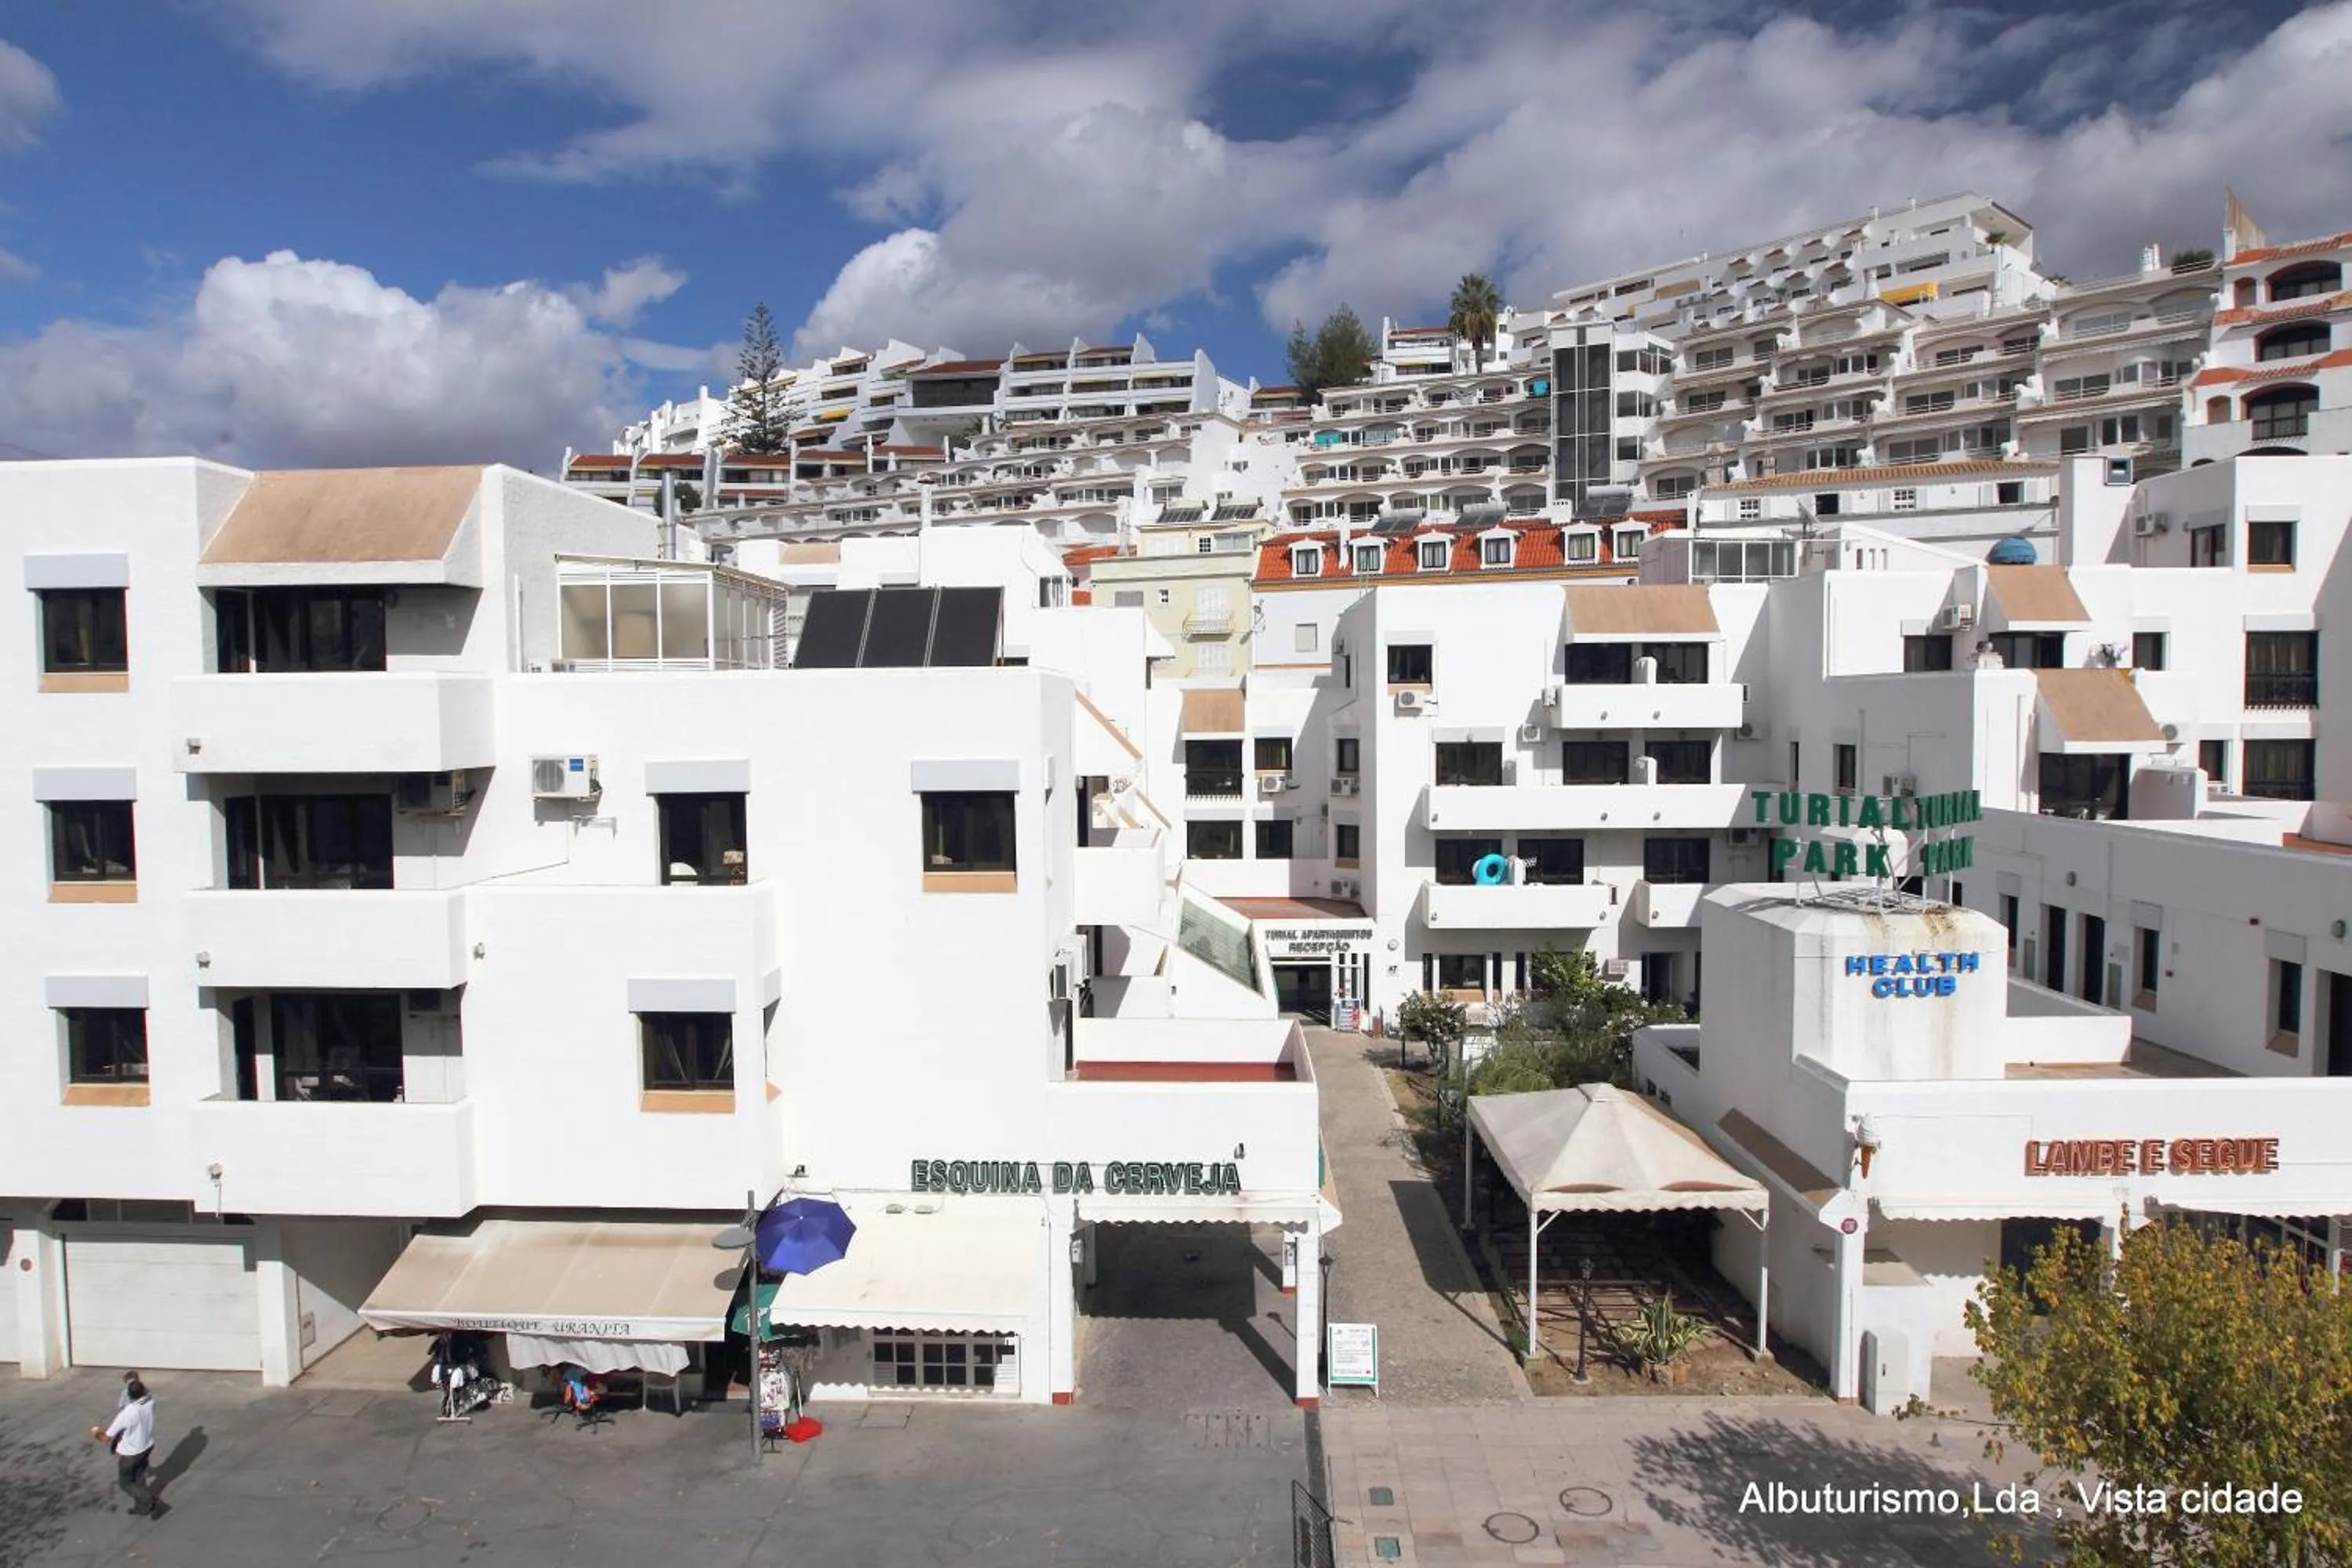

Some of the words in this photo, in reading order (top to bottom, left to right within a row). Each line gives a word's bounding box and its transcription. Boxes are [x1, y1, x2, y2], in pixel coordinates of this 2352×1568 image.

[1751, 791, 1911, 831] TURIAL
[1916, 789, 1983, 829] TURIAL
[1773, 837, 1890, 879] PARK
[1923, 835, 1975, 877] PARK
[1845, 952, 1980, 976] HEALTH
[1871, 975, 1957, 999] CLUB
[2025, 1138, 2136, 1175] LAMBE
[2140, 1138, 2165, 1175] E
[2169, 1137, 2280, 1174] SEGUE
[910, 1159, 1043, 1196] ESQUINA
[1052, 1161, 1094, 1194] DA
[1104, 1161, 1242, 1196] CERVEJA
